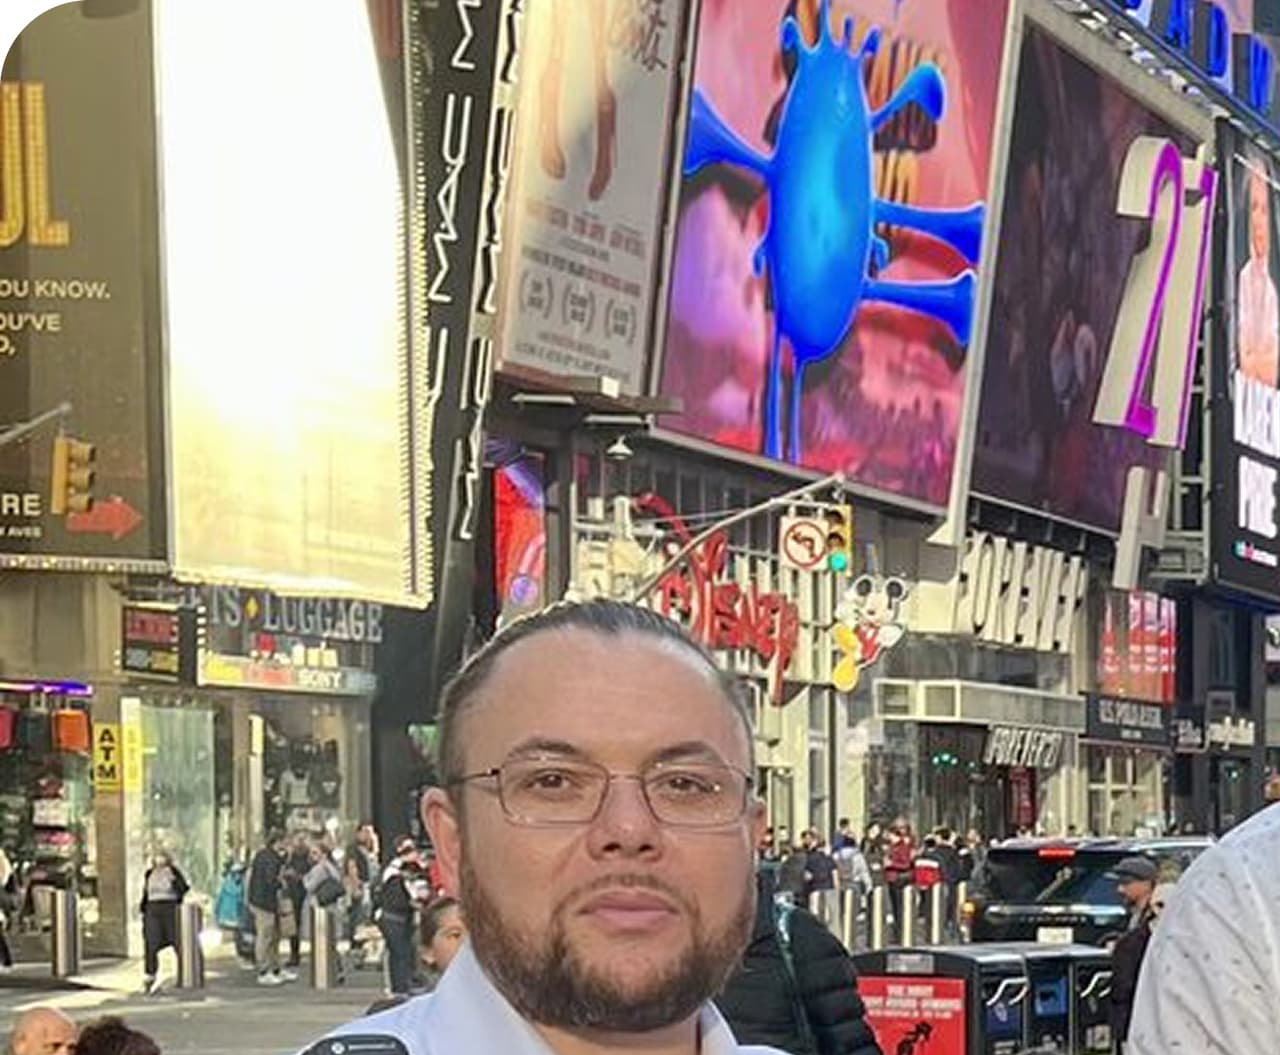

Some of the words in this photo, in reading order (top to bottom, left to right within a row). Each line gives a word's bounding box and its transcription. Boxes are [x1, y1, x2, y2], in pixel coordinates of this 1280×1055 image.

[35, 279, 111, 299] KNOW.
[264, 592, 384, 642] LUGGAGE
[299, 667, 341, 689] SONY
[97, 728, 116, 779] ATM
